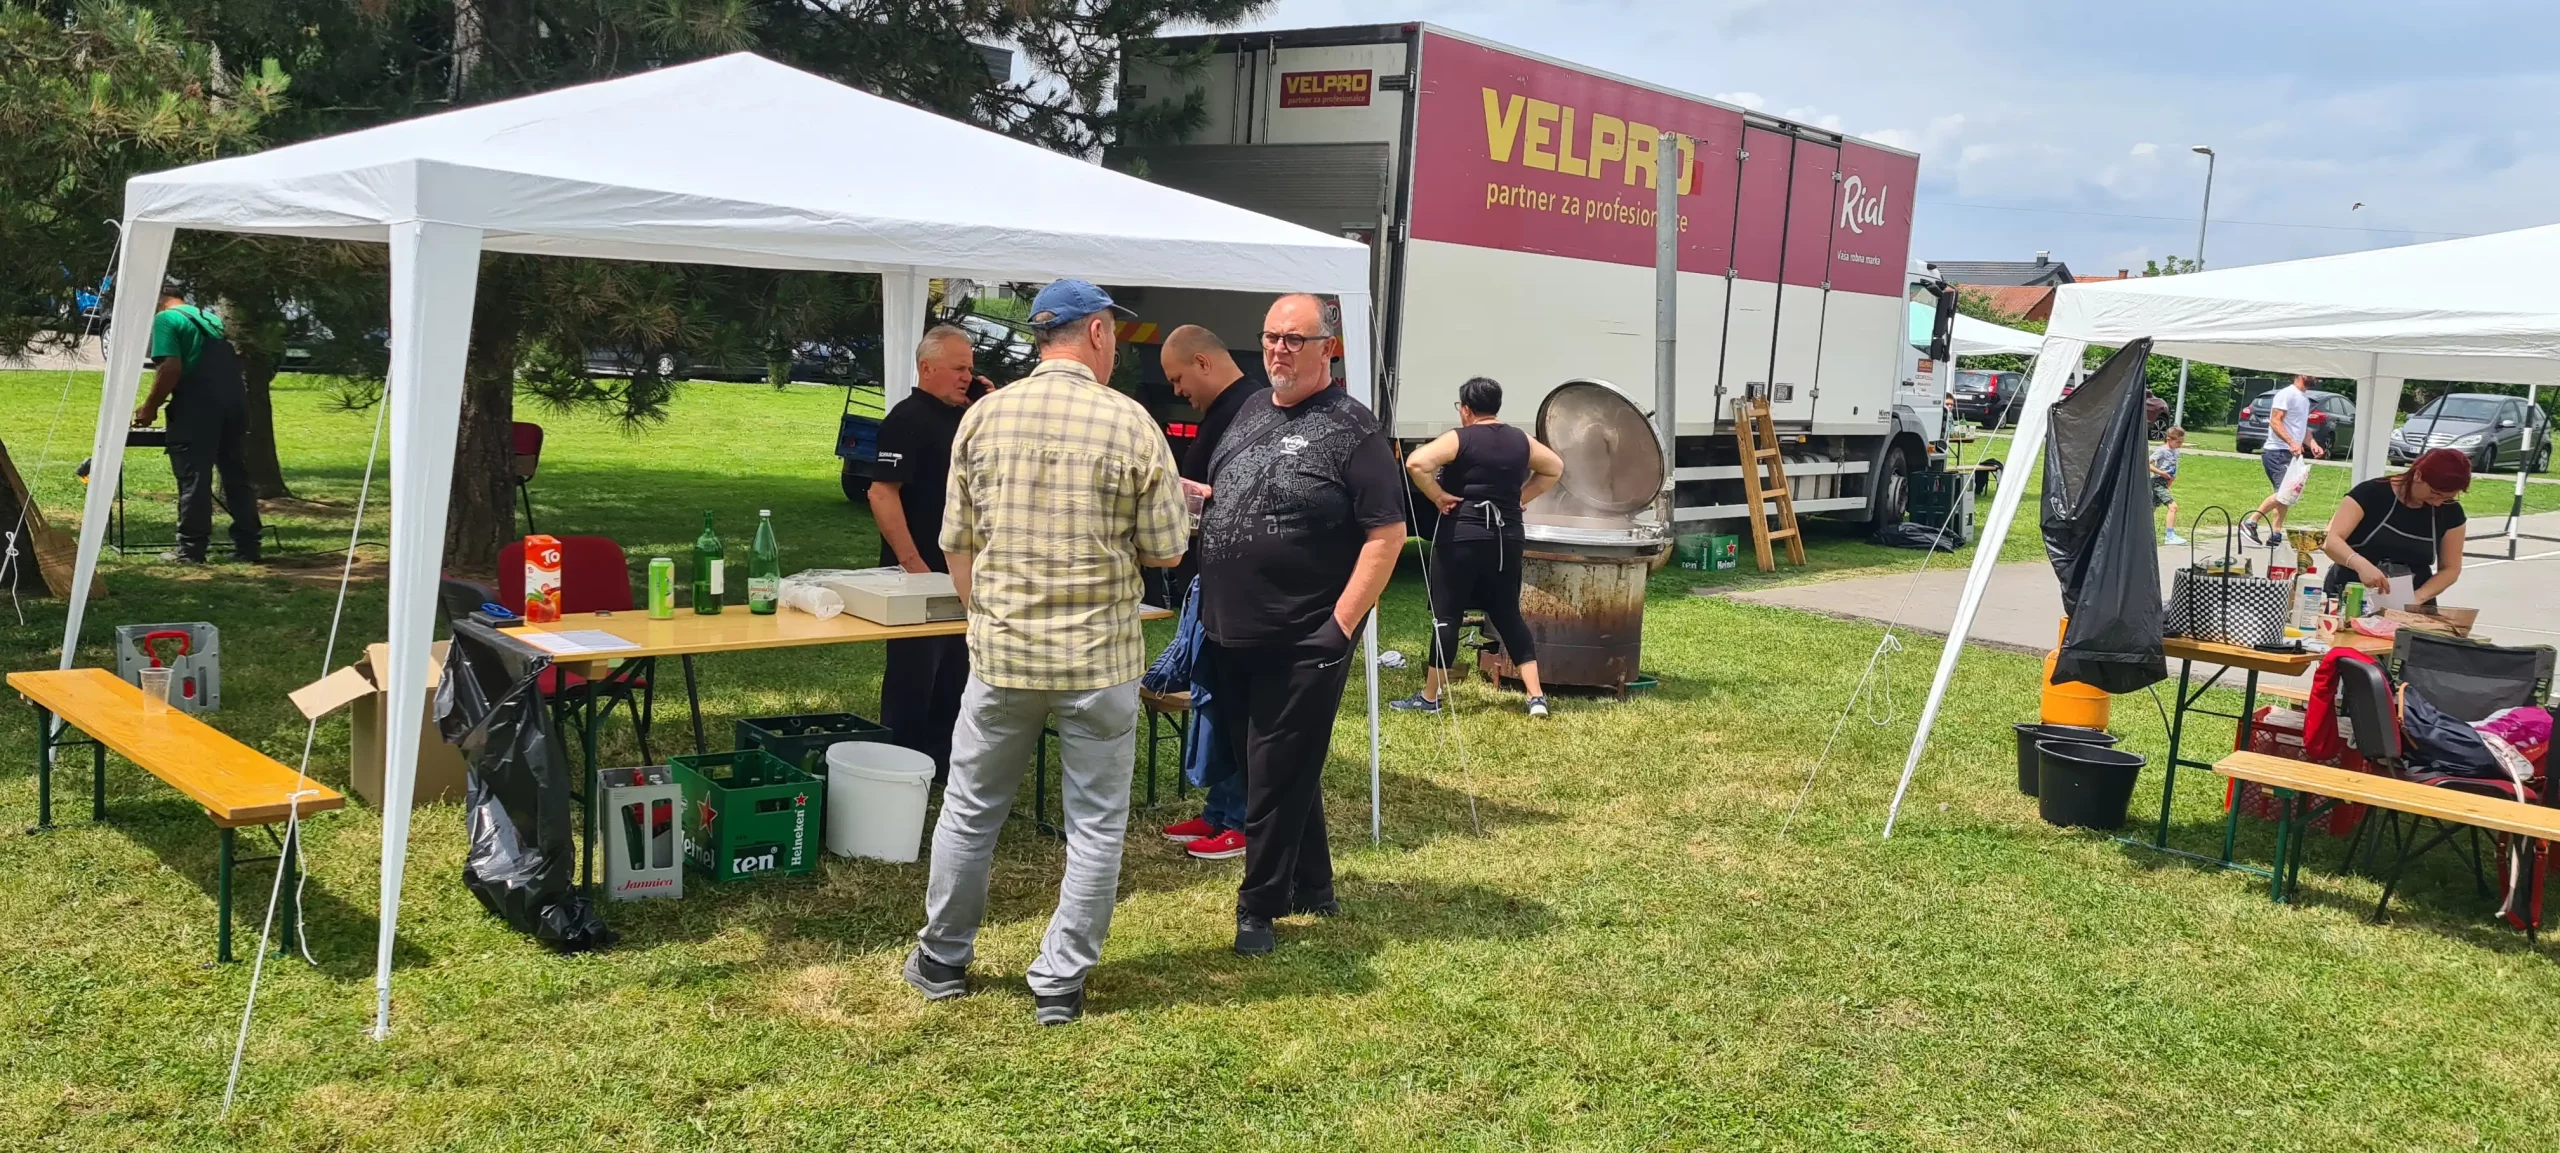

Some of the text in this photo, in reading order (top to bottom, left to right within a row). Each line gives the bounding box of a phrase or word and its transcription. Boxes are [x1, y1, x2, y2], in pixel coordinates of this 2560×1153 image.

[1286, 74, 1368, 94] VELPRO
[1287, 97, 1312, 106] partner
[1486, 182, 1556, 210] partner
[1561, 195, 1580, 216] za
[1840, 175, 1887, 234] Rial
[790, 809, 805, 867] Heineken
[617, 878, 673, 891] Jamnica
